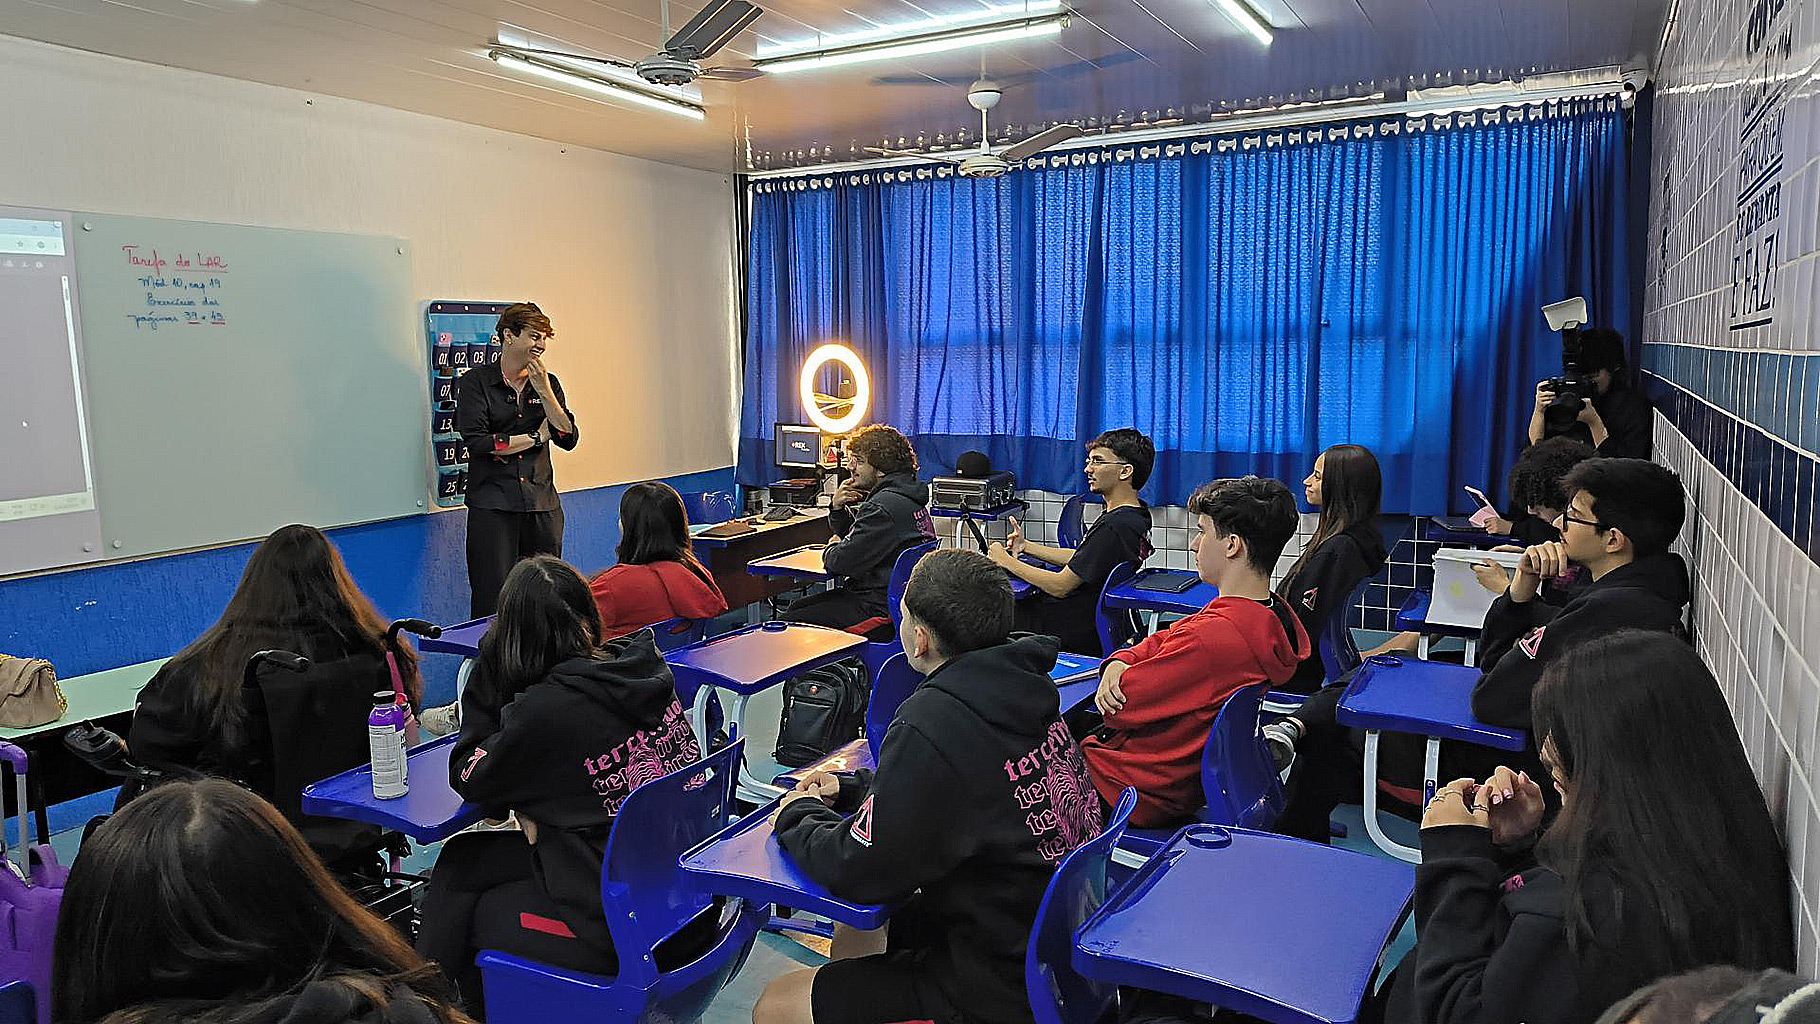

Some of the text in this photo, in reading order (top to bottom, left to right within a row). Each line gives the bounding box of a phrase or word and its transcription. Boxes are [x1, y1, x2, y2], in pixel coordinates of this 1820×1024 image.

[122, 245, 228, 275] Tarefa do LAR
[1731, 257, 1741, 318] E
[1742, 229, 1780, 316] FAZ!
[209, 278, 221, 289] 19
[439, 353, 448, 365] 01
[454, 352, 466, 364] 02
[473, 351, 484, 363] 03
[440, 385, 451, 397] 07
[440, 419, 452, 430] 13
[444, 448, 455, 461] 19
[445, 481, 457, 493] 25
